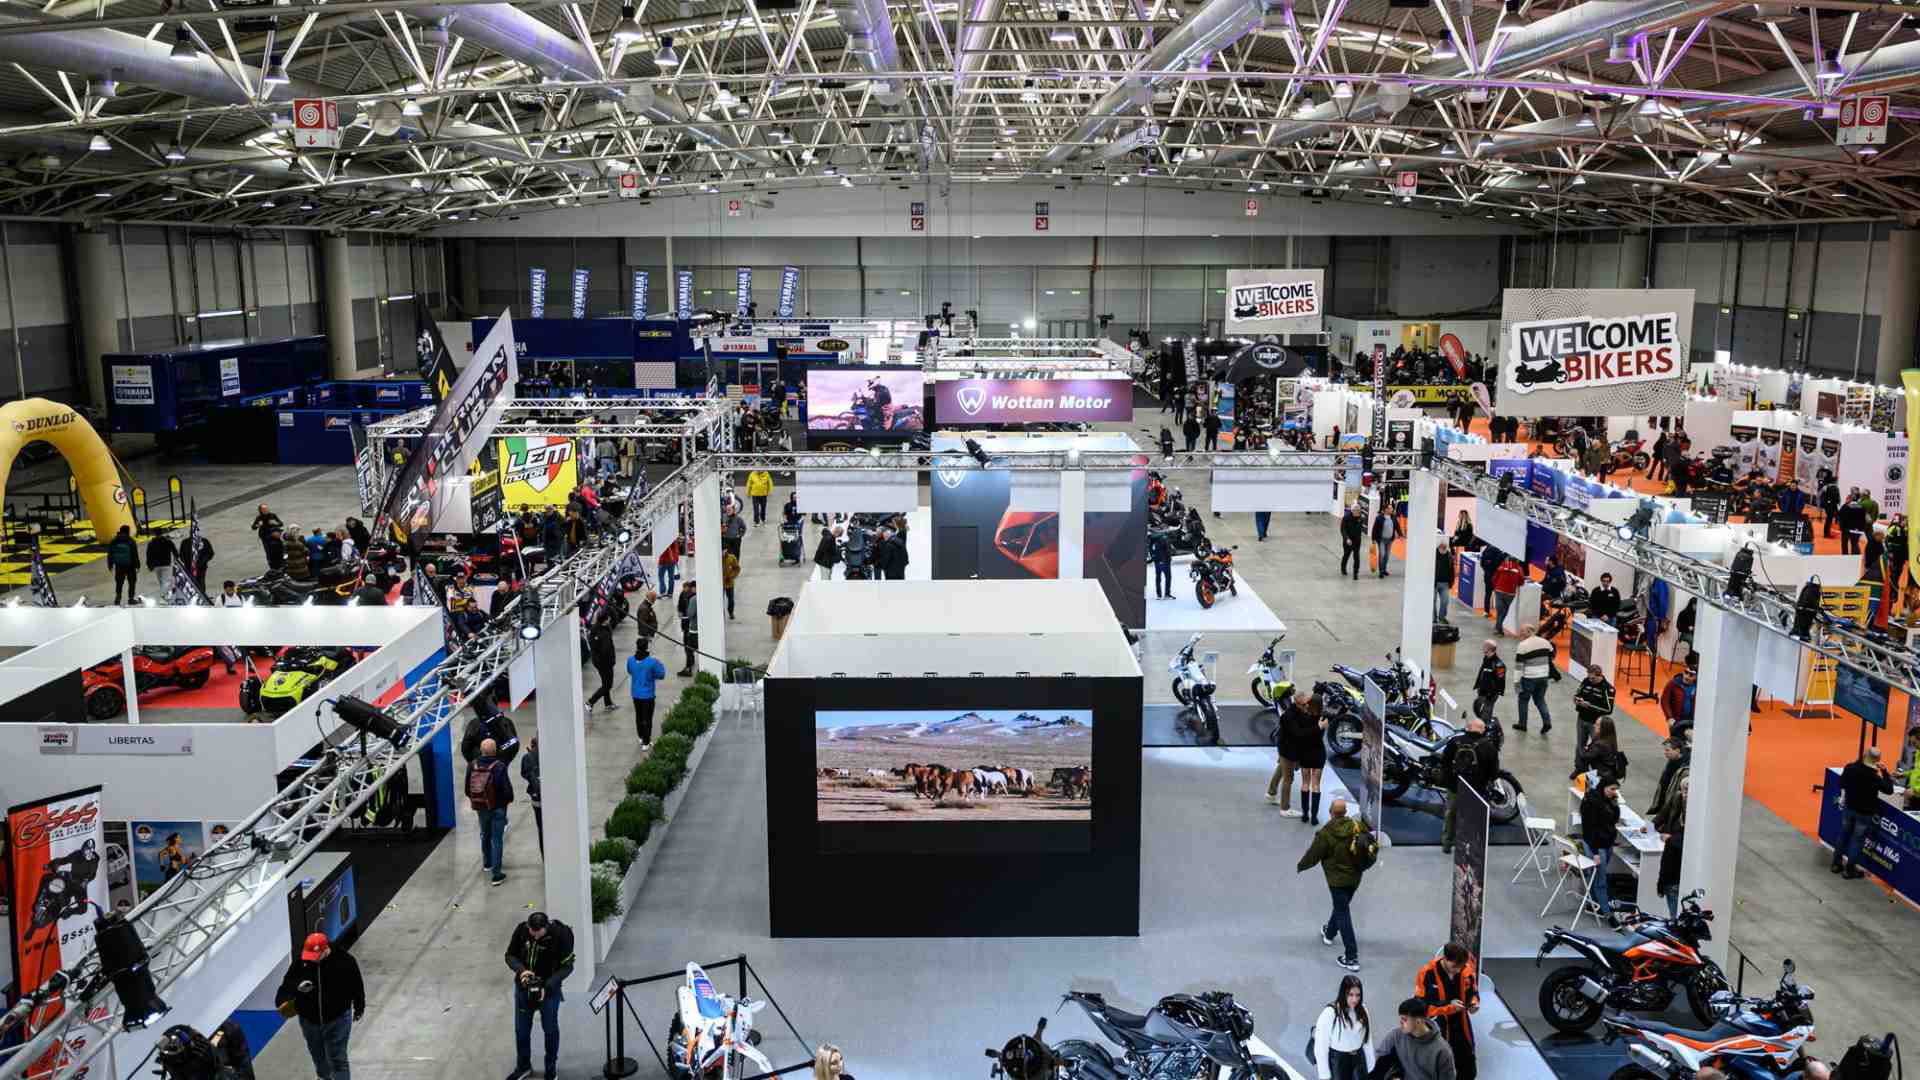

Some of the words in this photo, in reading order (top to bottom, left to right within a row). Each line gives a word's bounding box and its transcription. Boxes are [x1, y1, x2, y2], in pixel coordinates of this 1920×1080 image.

[635, 276, 645, 310] YAMAHA
[679, 276, 689, 310] YAMAHA
[738, 272, 748, 309] YAMAHA
[782, 272, 795, 307] YAMAHA
[1238, 284, 1314, 305] WELCOME
[1259, 299, 1315, 317] BIKERS
[1522, 318, 1672, 358] WELCOME
[1565, 347, 1673, 382] BIKERS
[991, 395, 1054, 409] Wottan
[1059, 394, 1112, 409] Motor
[26, 413, 77, 431] DUNLOP
[506, 443, 573, 475] LEM
[108, 736, 155, 745] LIBERTAS
